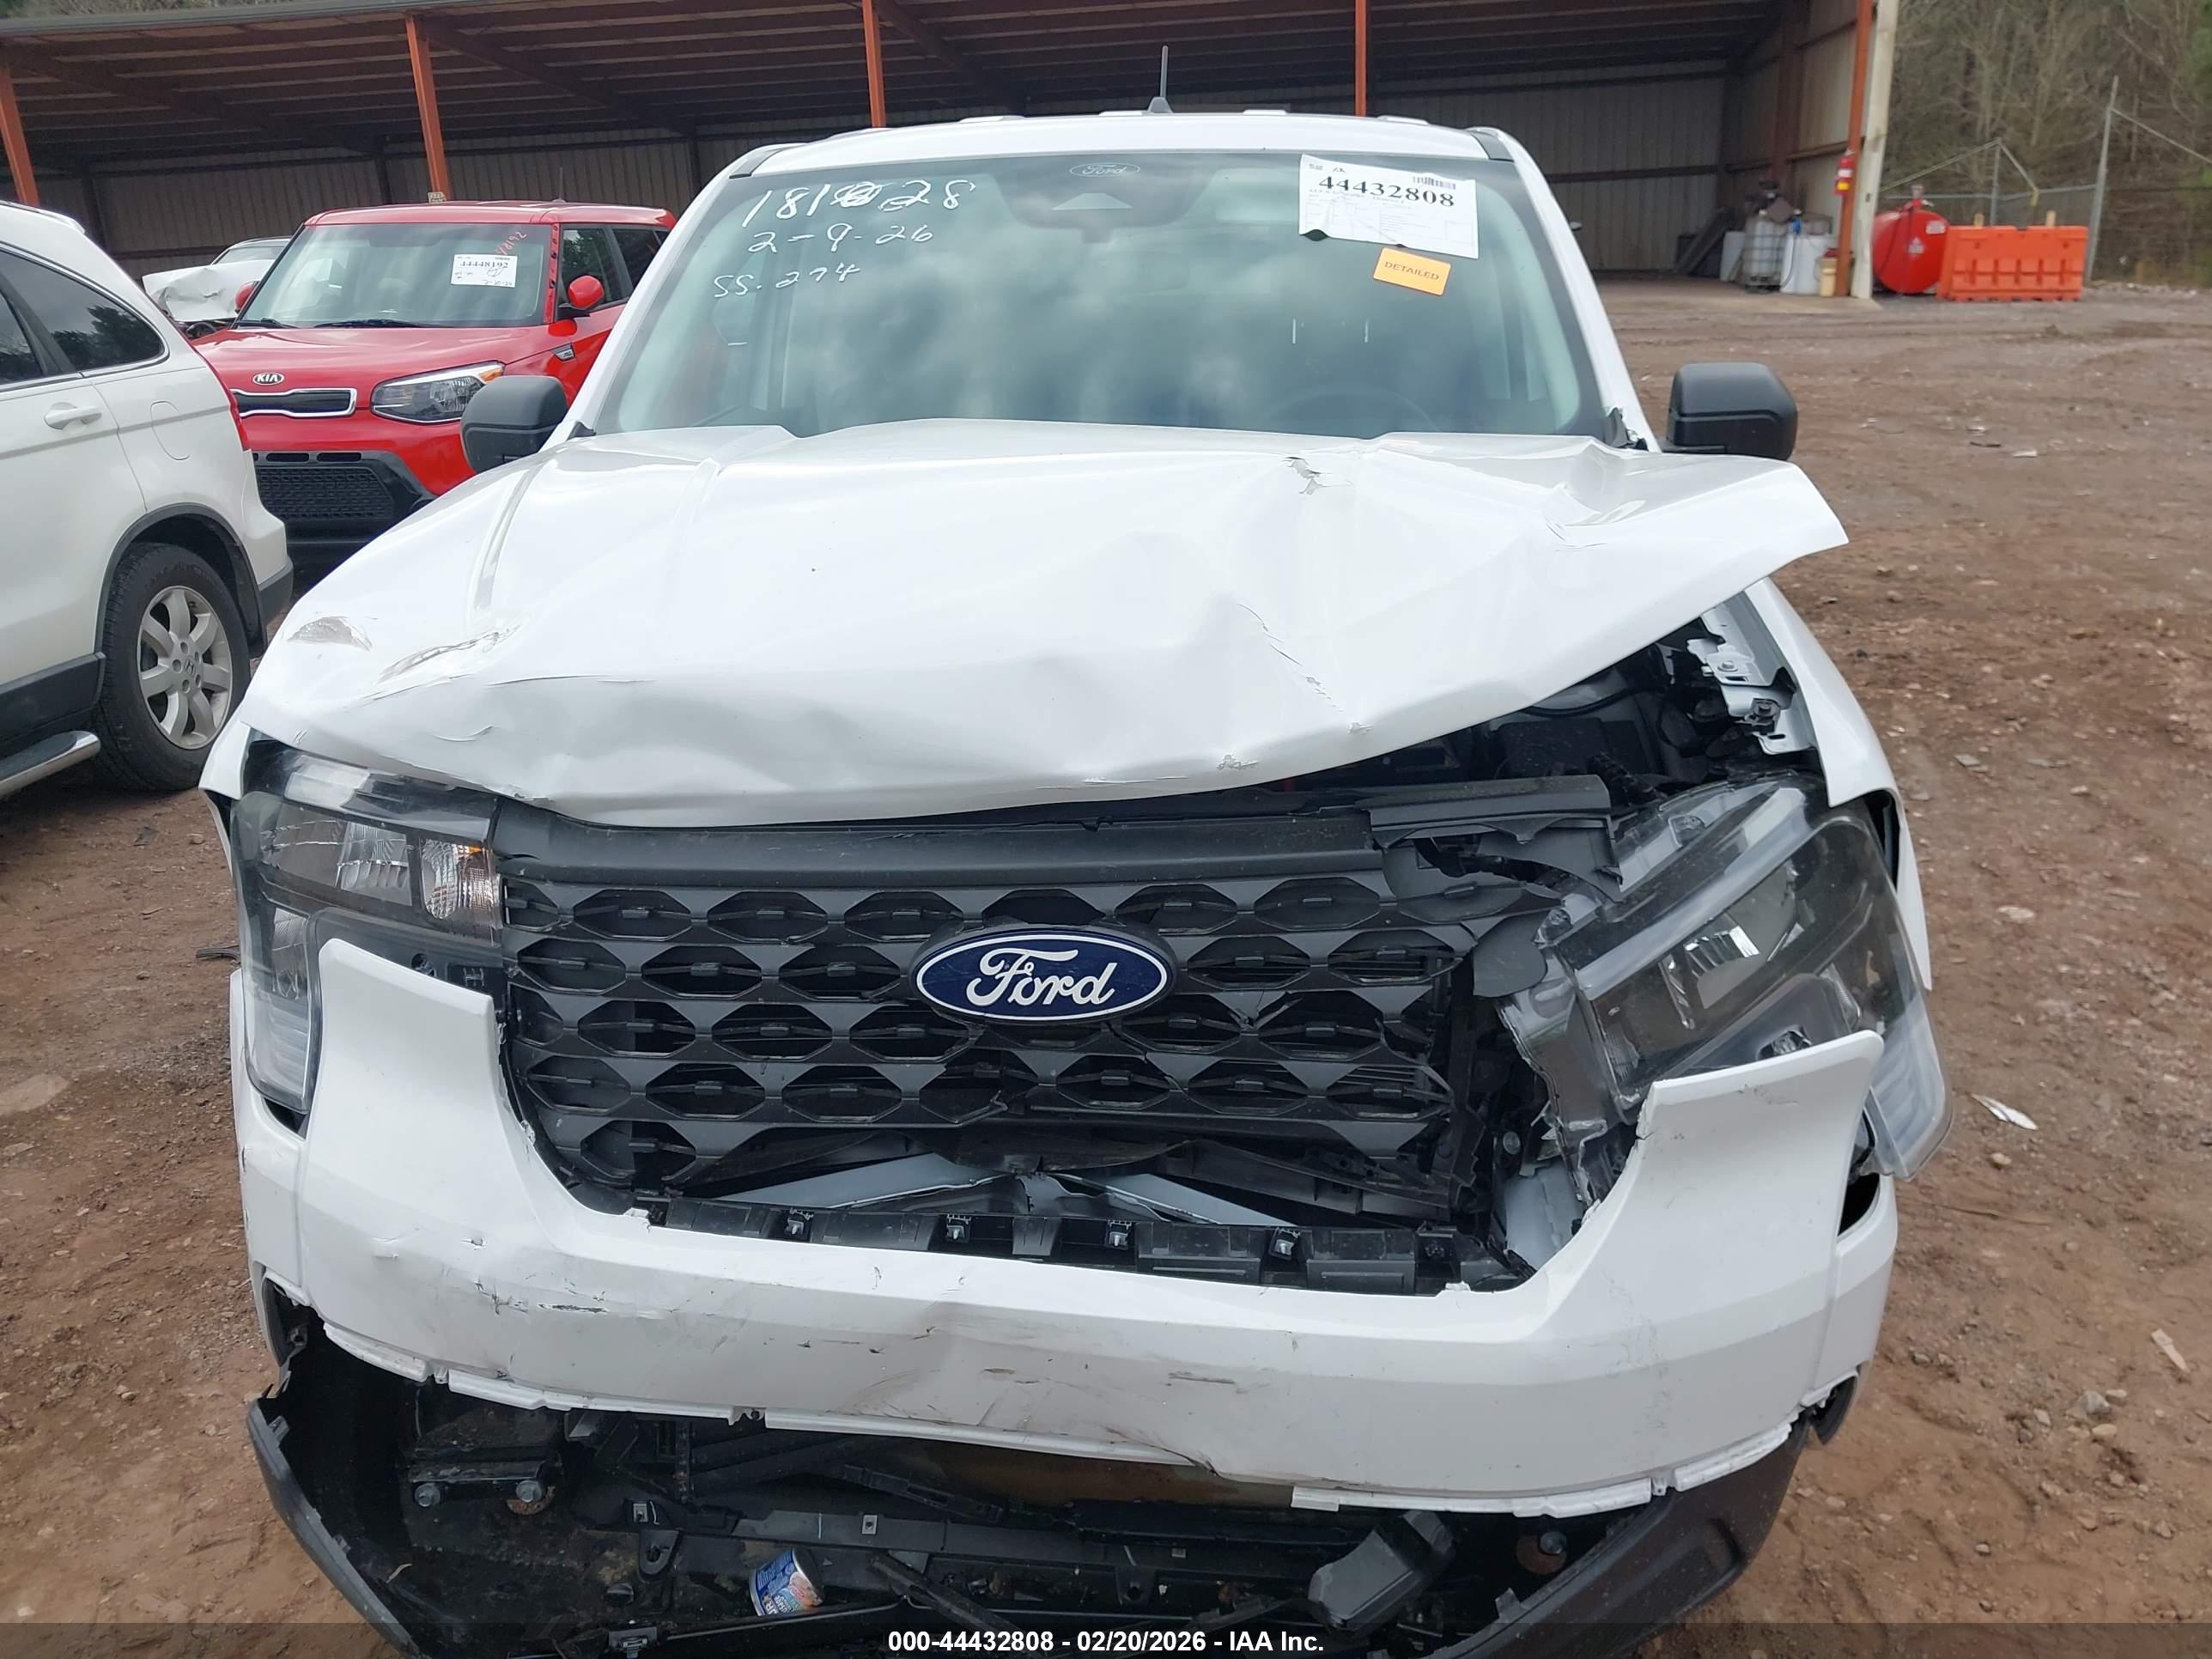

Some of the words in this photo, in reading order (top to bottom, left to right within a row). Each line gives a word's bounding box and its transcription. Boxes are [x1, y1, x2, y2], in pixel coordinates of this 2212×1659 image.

[1319, 176, 1455, 207] 44432808
[1384, 261, 1439, 281] DETAILED
[257, 374, 278, 382] KIA
[966, 947, 1118, 1006] Ford
